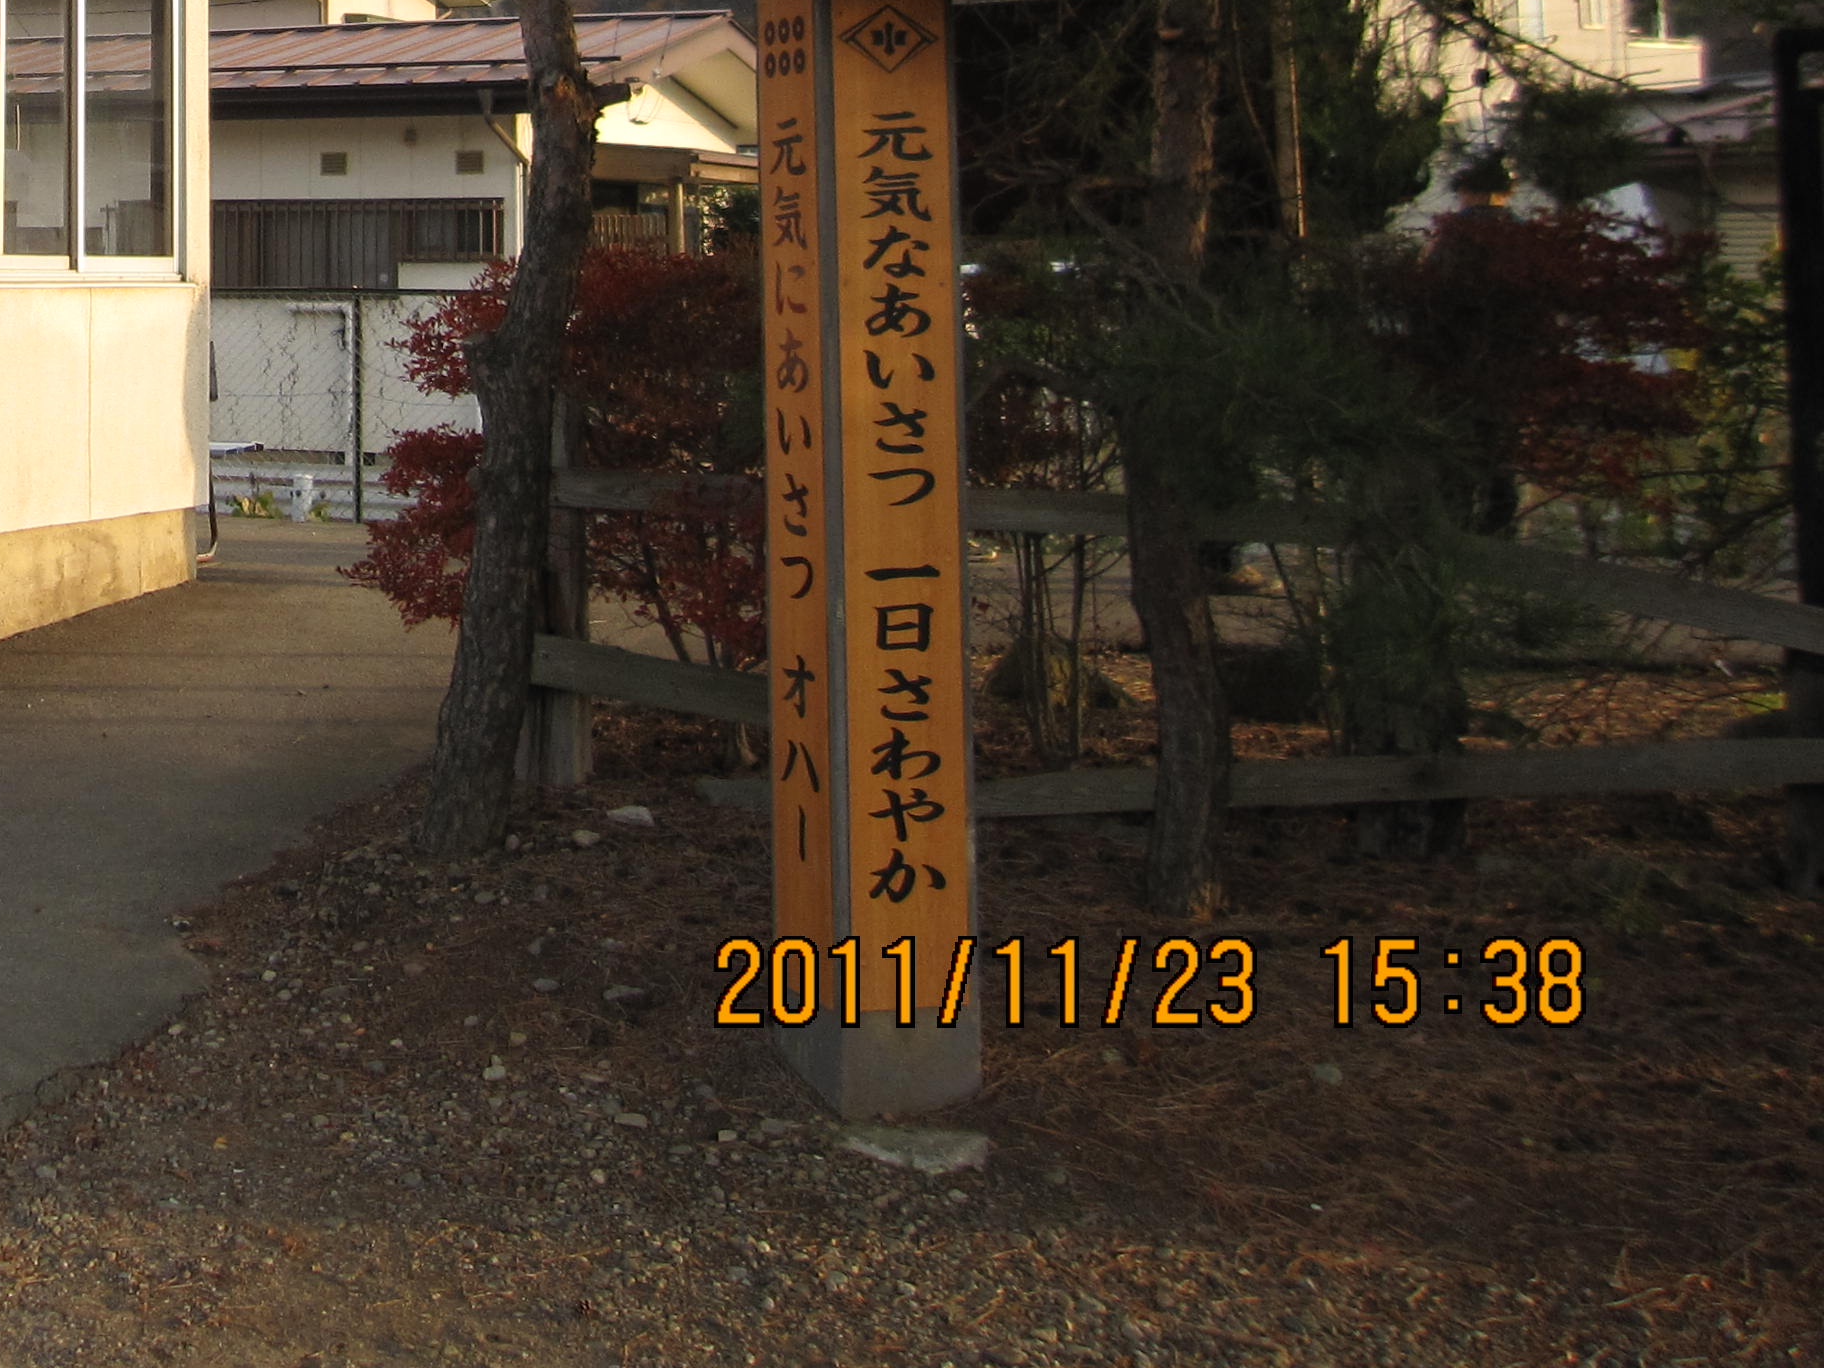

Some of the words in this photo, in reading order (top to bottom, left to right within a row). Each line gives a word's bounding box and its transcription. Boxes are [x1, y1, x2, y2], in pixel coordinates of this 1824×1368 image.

[769, 117, 814, 600] 元気にあいさつ
[857, 110, 936, 507] 元気なあいさつ
[863, 563, 948, 905] 一日さわやか
